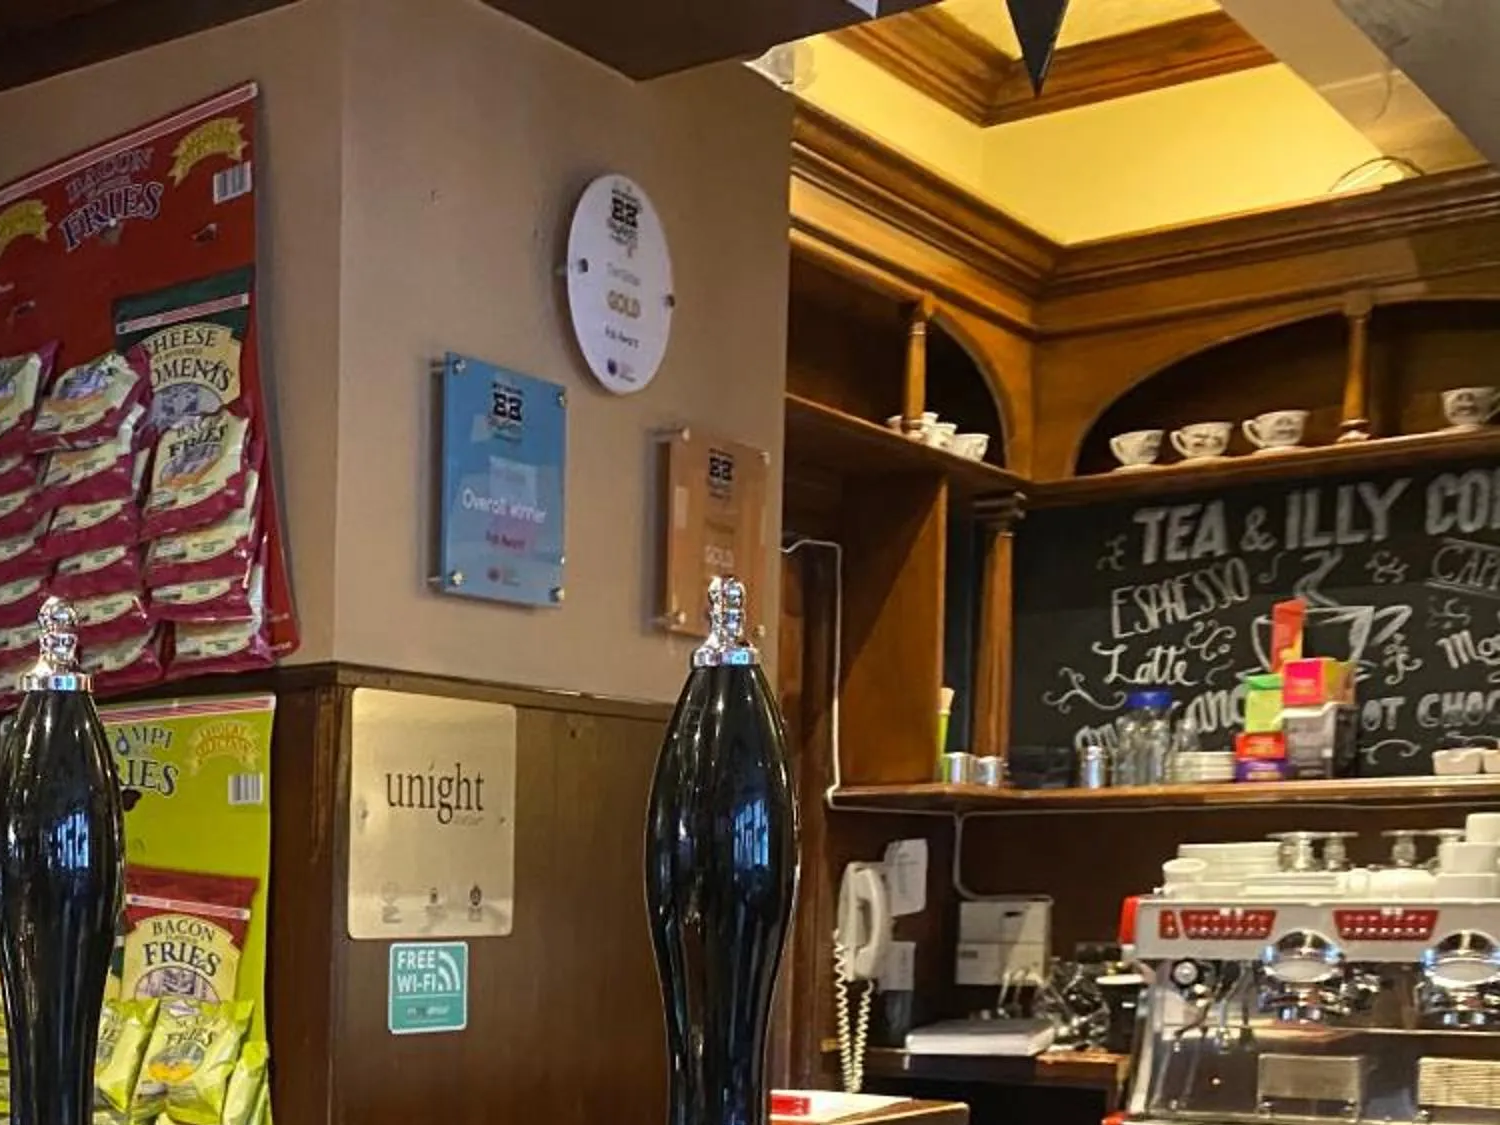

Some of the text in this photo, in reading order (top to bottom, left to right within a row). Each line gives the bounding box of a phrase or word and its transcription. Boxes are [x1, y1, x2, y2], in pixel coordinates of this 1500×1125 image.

[59, 181, 164, 251] FRIES
[153, 356, 234, 392] MENTS
[1133, 500, 1230, 566] TEA
[1239, 505, 1279, 551] &
[1285, 476, 1414, 551] ILLY
[1092, 640, 1200, 687] Latte
[1361, 697, 1406, 736] OT
[112, 758, 180, 797] IES
[152, 918, 216, 942] BACON
[142, 940, 222, 978] FRIES
[396, 949, 437, 970] FREE
[396, 973, 437, 993] WI-FI
